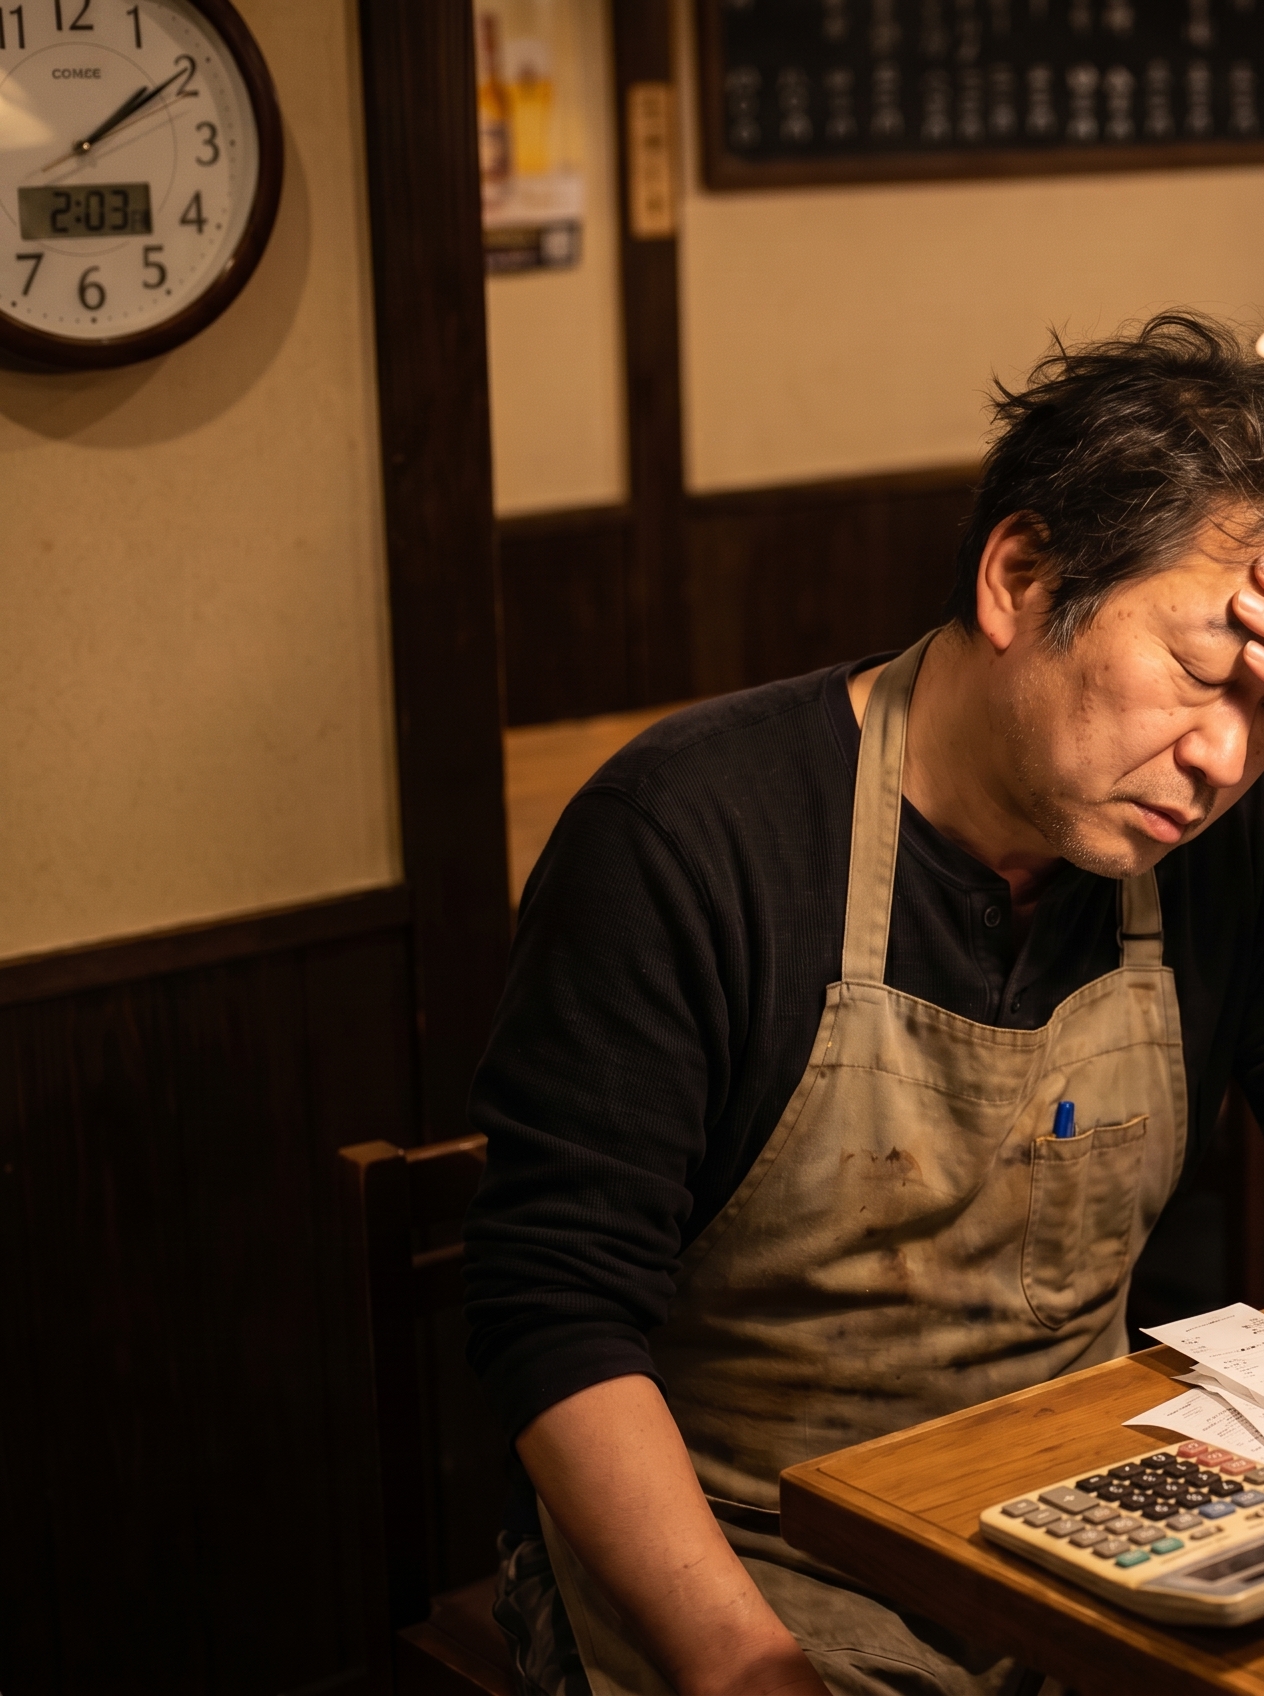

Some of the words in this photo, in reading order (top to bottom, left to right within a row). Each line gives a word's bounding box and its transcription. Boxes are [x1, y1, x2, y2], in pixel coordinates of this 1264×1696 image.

[126, 4, 143, 49] 1
[174, 54, 199, 96] 2
[195, 121, 220, 167] 3
[51, 189, 129, 233] 2:03
[179, 189, 208, 234] 4
[16, 253, 44, 296] 7
[78, 265, 106, 311] 6
[142, 246, 167, 290] 5
